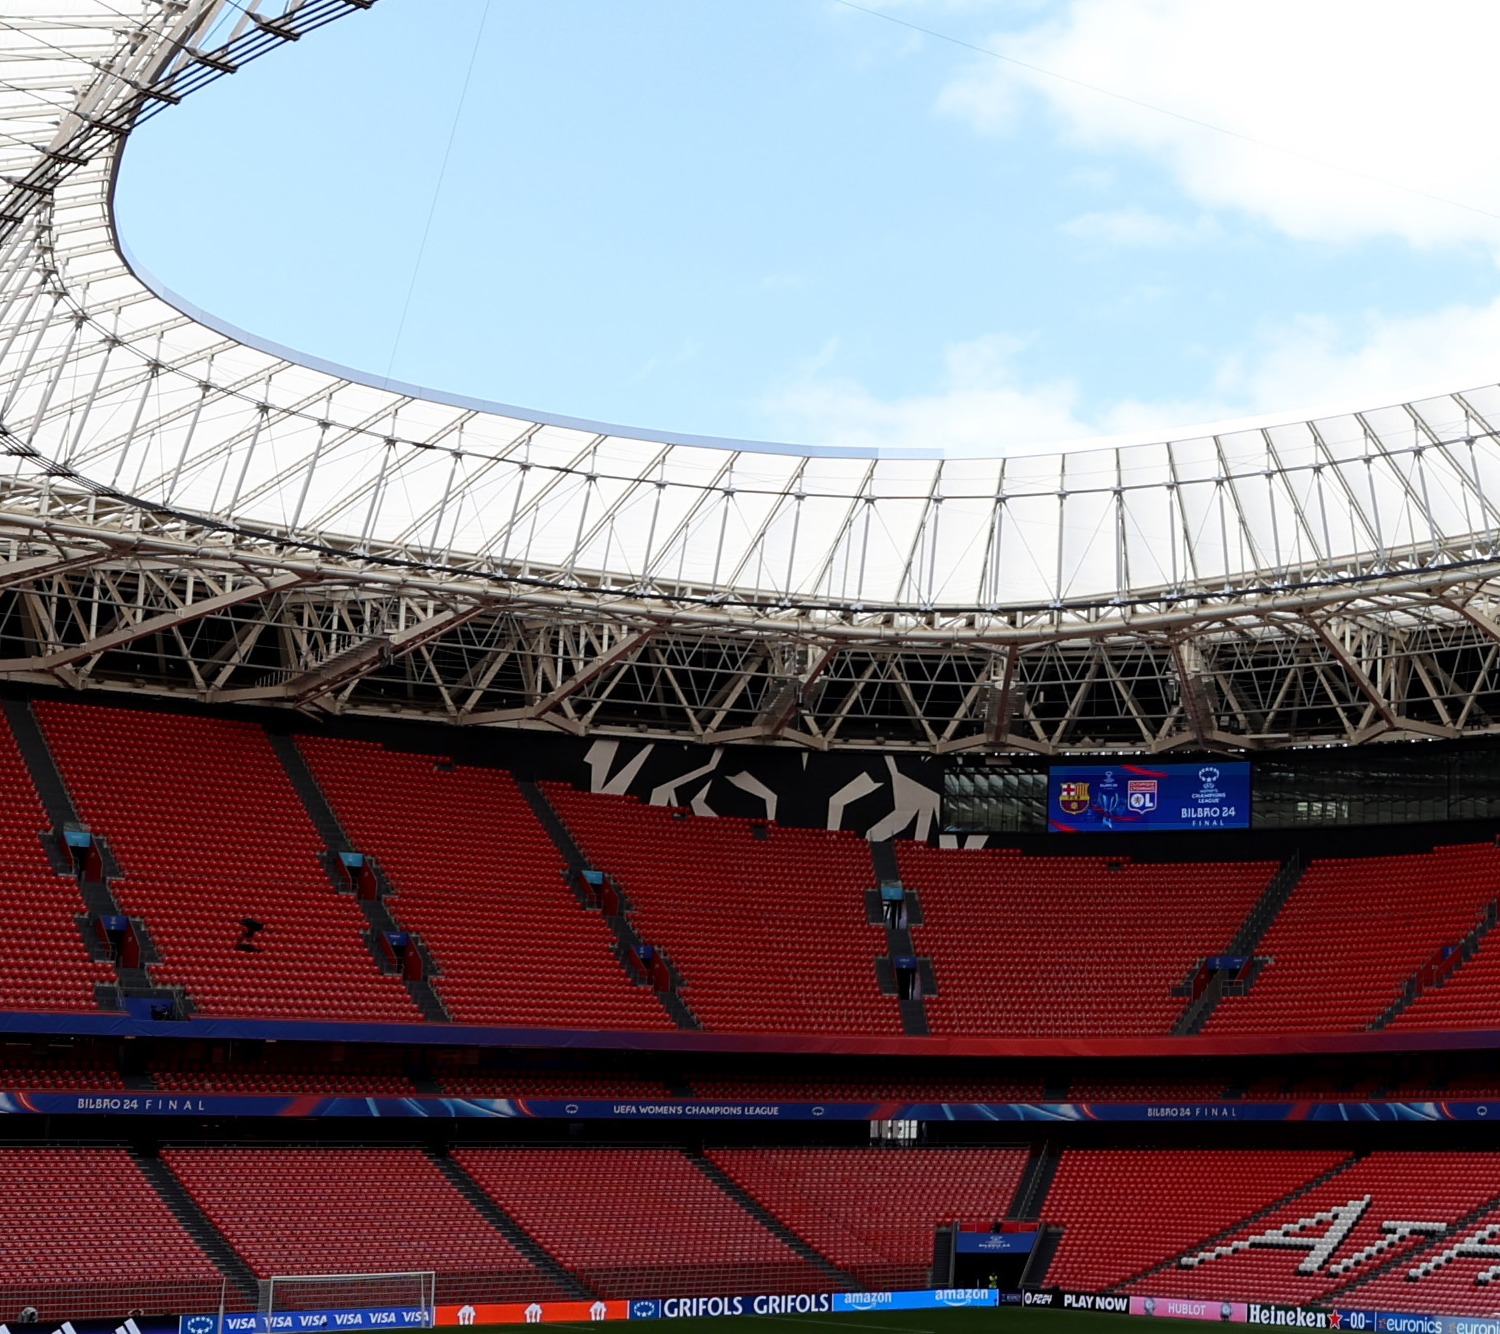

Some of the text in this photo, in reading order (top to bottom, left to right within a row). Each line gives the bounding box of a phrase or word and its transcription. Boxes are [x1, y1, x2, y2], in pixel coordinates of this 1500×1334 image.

[1181, 806, 1236, 818] BILBAO 24
[78, 1098, 204, 1111] BILBAO 24 FINAL
[613, 1105, 779, 1115] UEFA WOMEN'S CHAMPIONS LEAGUE
[1147, 1107, 1236, 1117] BILBAO 24 FINAL
[844, 1292, 892, 1304] amazon
[935, 1288, 989, 1301] amazon
[663, 1296, 743, 1317] GRIFOLS
[753, 1294, 829, 1315] GRIFOLS
[1064, 1294, 1128, 1311] PLAY NOW
[1168, 1303, 1206, 1316] HUBLOT
[298, 1315, 327, 1326] VISA
[333, 1314, 362, 1325] VISA
[368, 1312, 396, 1324] VISA
[401, 1311, 429, 1322] VISA
[1249, 1304, 1327, 1328] Heineken
[226, 1318, 257, 1329] VISA
[263, 1317, 292, 1328] VISA
[1386, 1317, 1443, 1334] euronics
